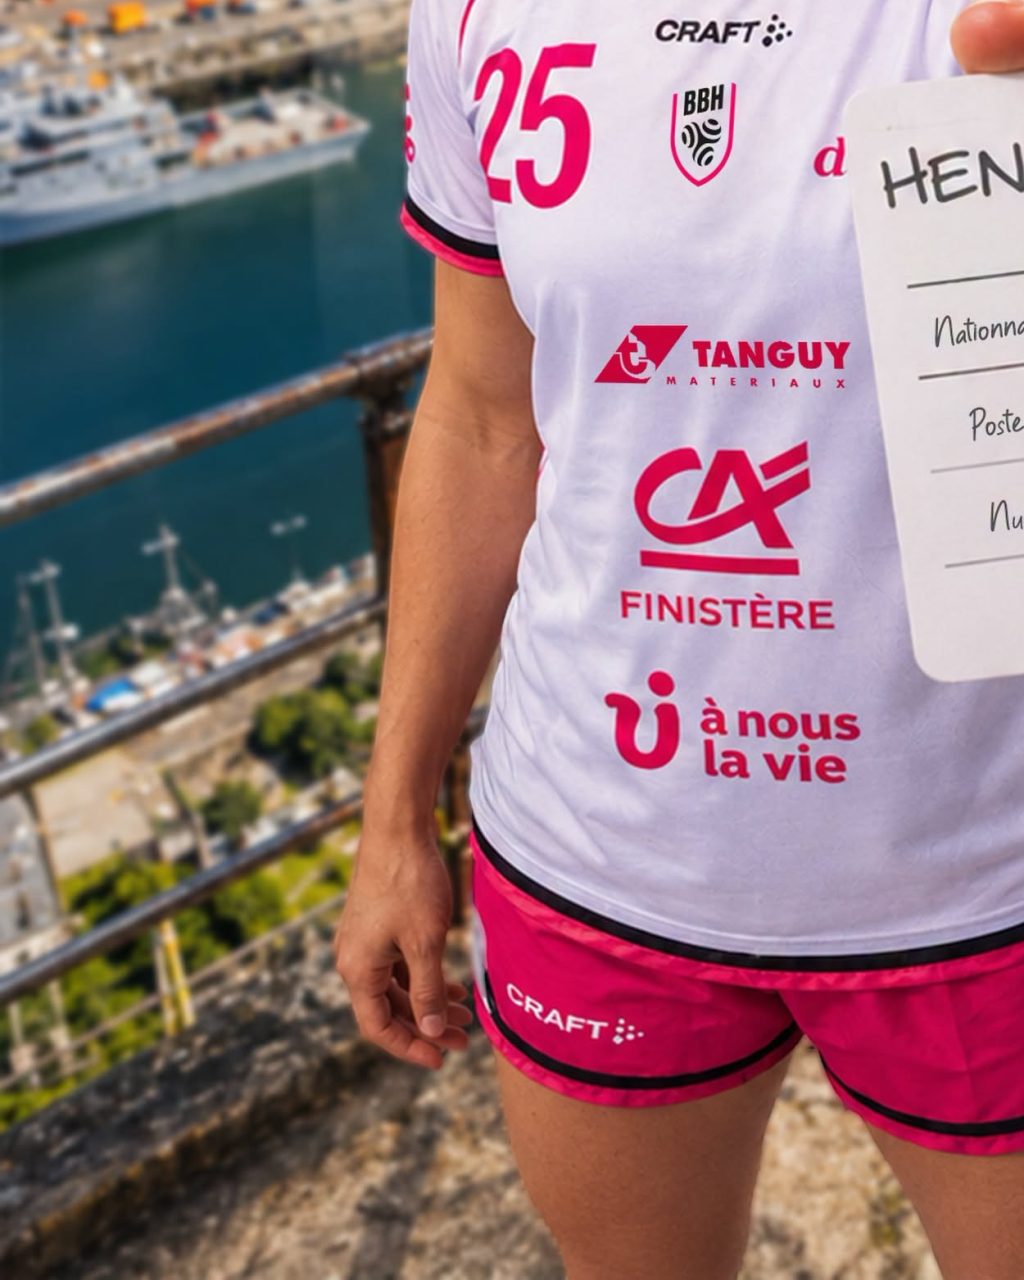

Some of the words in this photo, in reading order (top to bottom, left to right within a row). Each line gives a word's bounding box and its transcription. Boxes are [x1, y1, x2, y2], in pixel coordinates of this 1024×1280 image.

[656, 20, 760, 43] CRAFT
[684, 85, 724, 115] BBH
[474, 43, 596, 208] 25
[693, 340, 850, 369] TANGUY
[970, 408, 1024, 440] Poste
[621, 591, 834, 629] FINISTÈRE
[701, 697, 727, 735] à
[738, 711, 860, 740] nous
[704, 739, 749, 778] la
[763, 743, 846, 783] vie
[506, 983, 608, 1039] CRAFT
